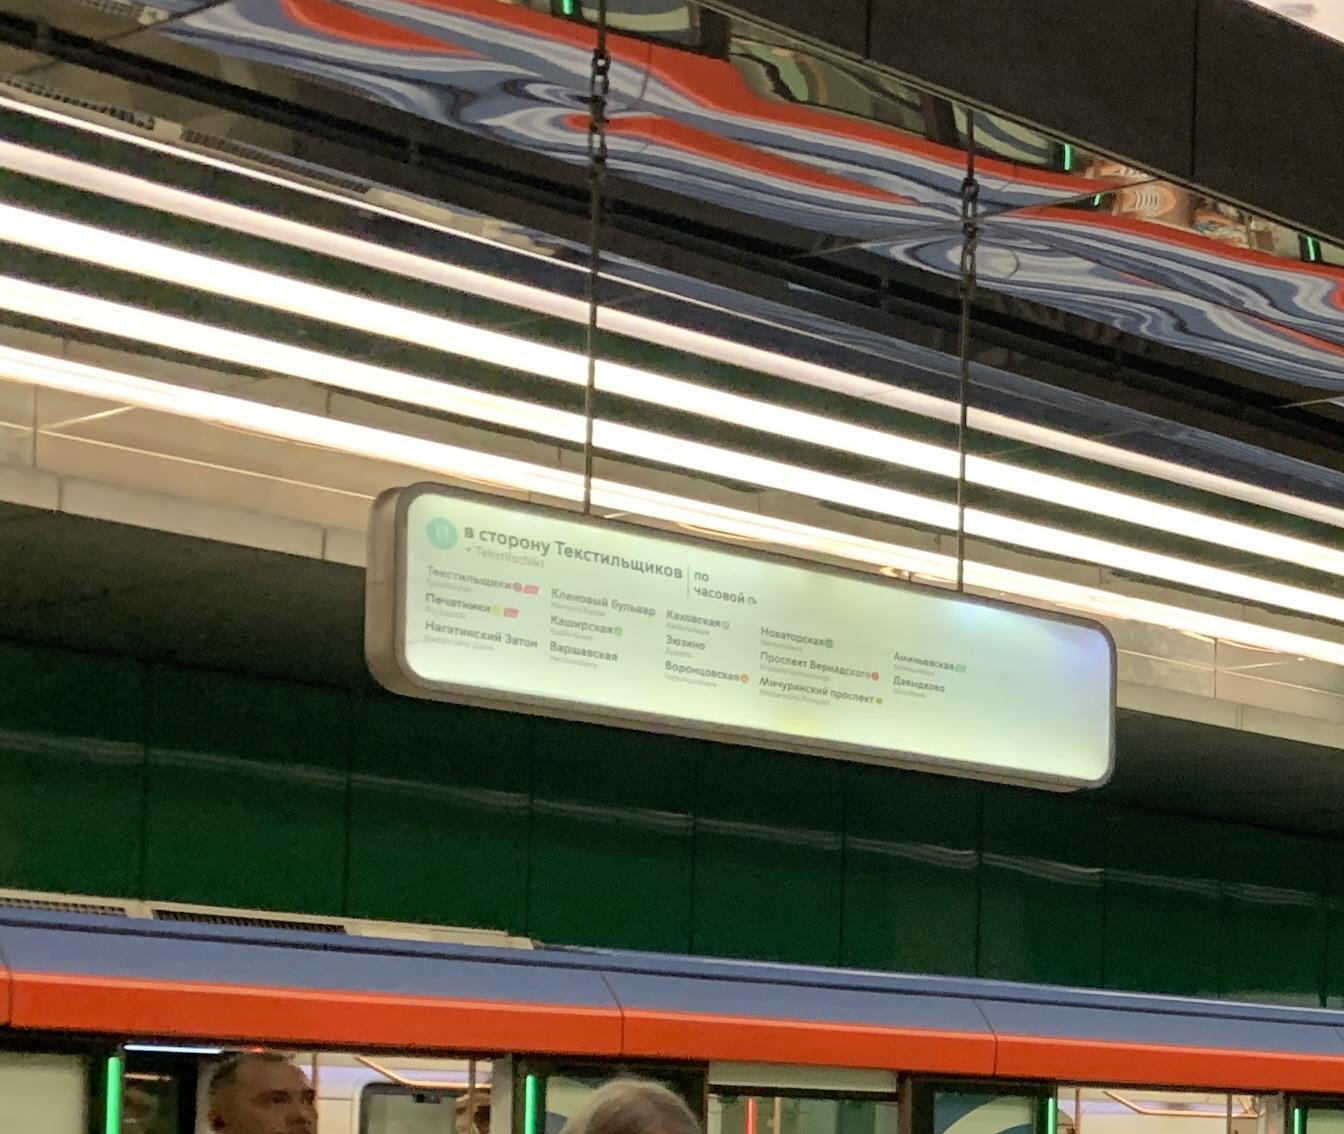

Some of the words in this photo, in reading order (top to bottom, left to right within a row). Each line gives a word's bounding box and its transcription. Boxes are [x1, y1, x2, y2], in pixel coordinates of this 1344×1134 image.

[464, 526, 474, 540] в
[479, 530, 551, 557] сторону
[554, 540, 683, 579] Текстильщиков
[427, 565, 512, 590] Текстильщики
[694, 571, 709, 582] по
[425, 593, 491, 613] Печатники
[694, 586, 745, 604] часовой
[611, 598, 656, 618] бульвар
[550, 615, 613, 636] Каширская
[666, 609, 721, 628] Каховская
[424, 620, 502, 643] Нагатинский
[504, 633, 538, 649] Затон
[665, 635, 706, 651] Зюзино
[760, 626, 824, 648] Новаторская
[549, 641, 618, 661] Варшавская
[760, 651, 808, 668] Проспект
[665, 660, 740, 681] Воронцовская
